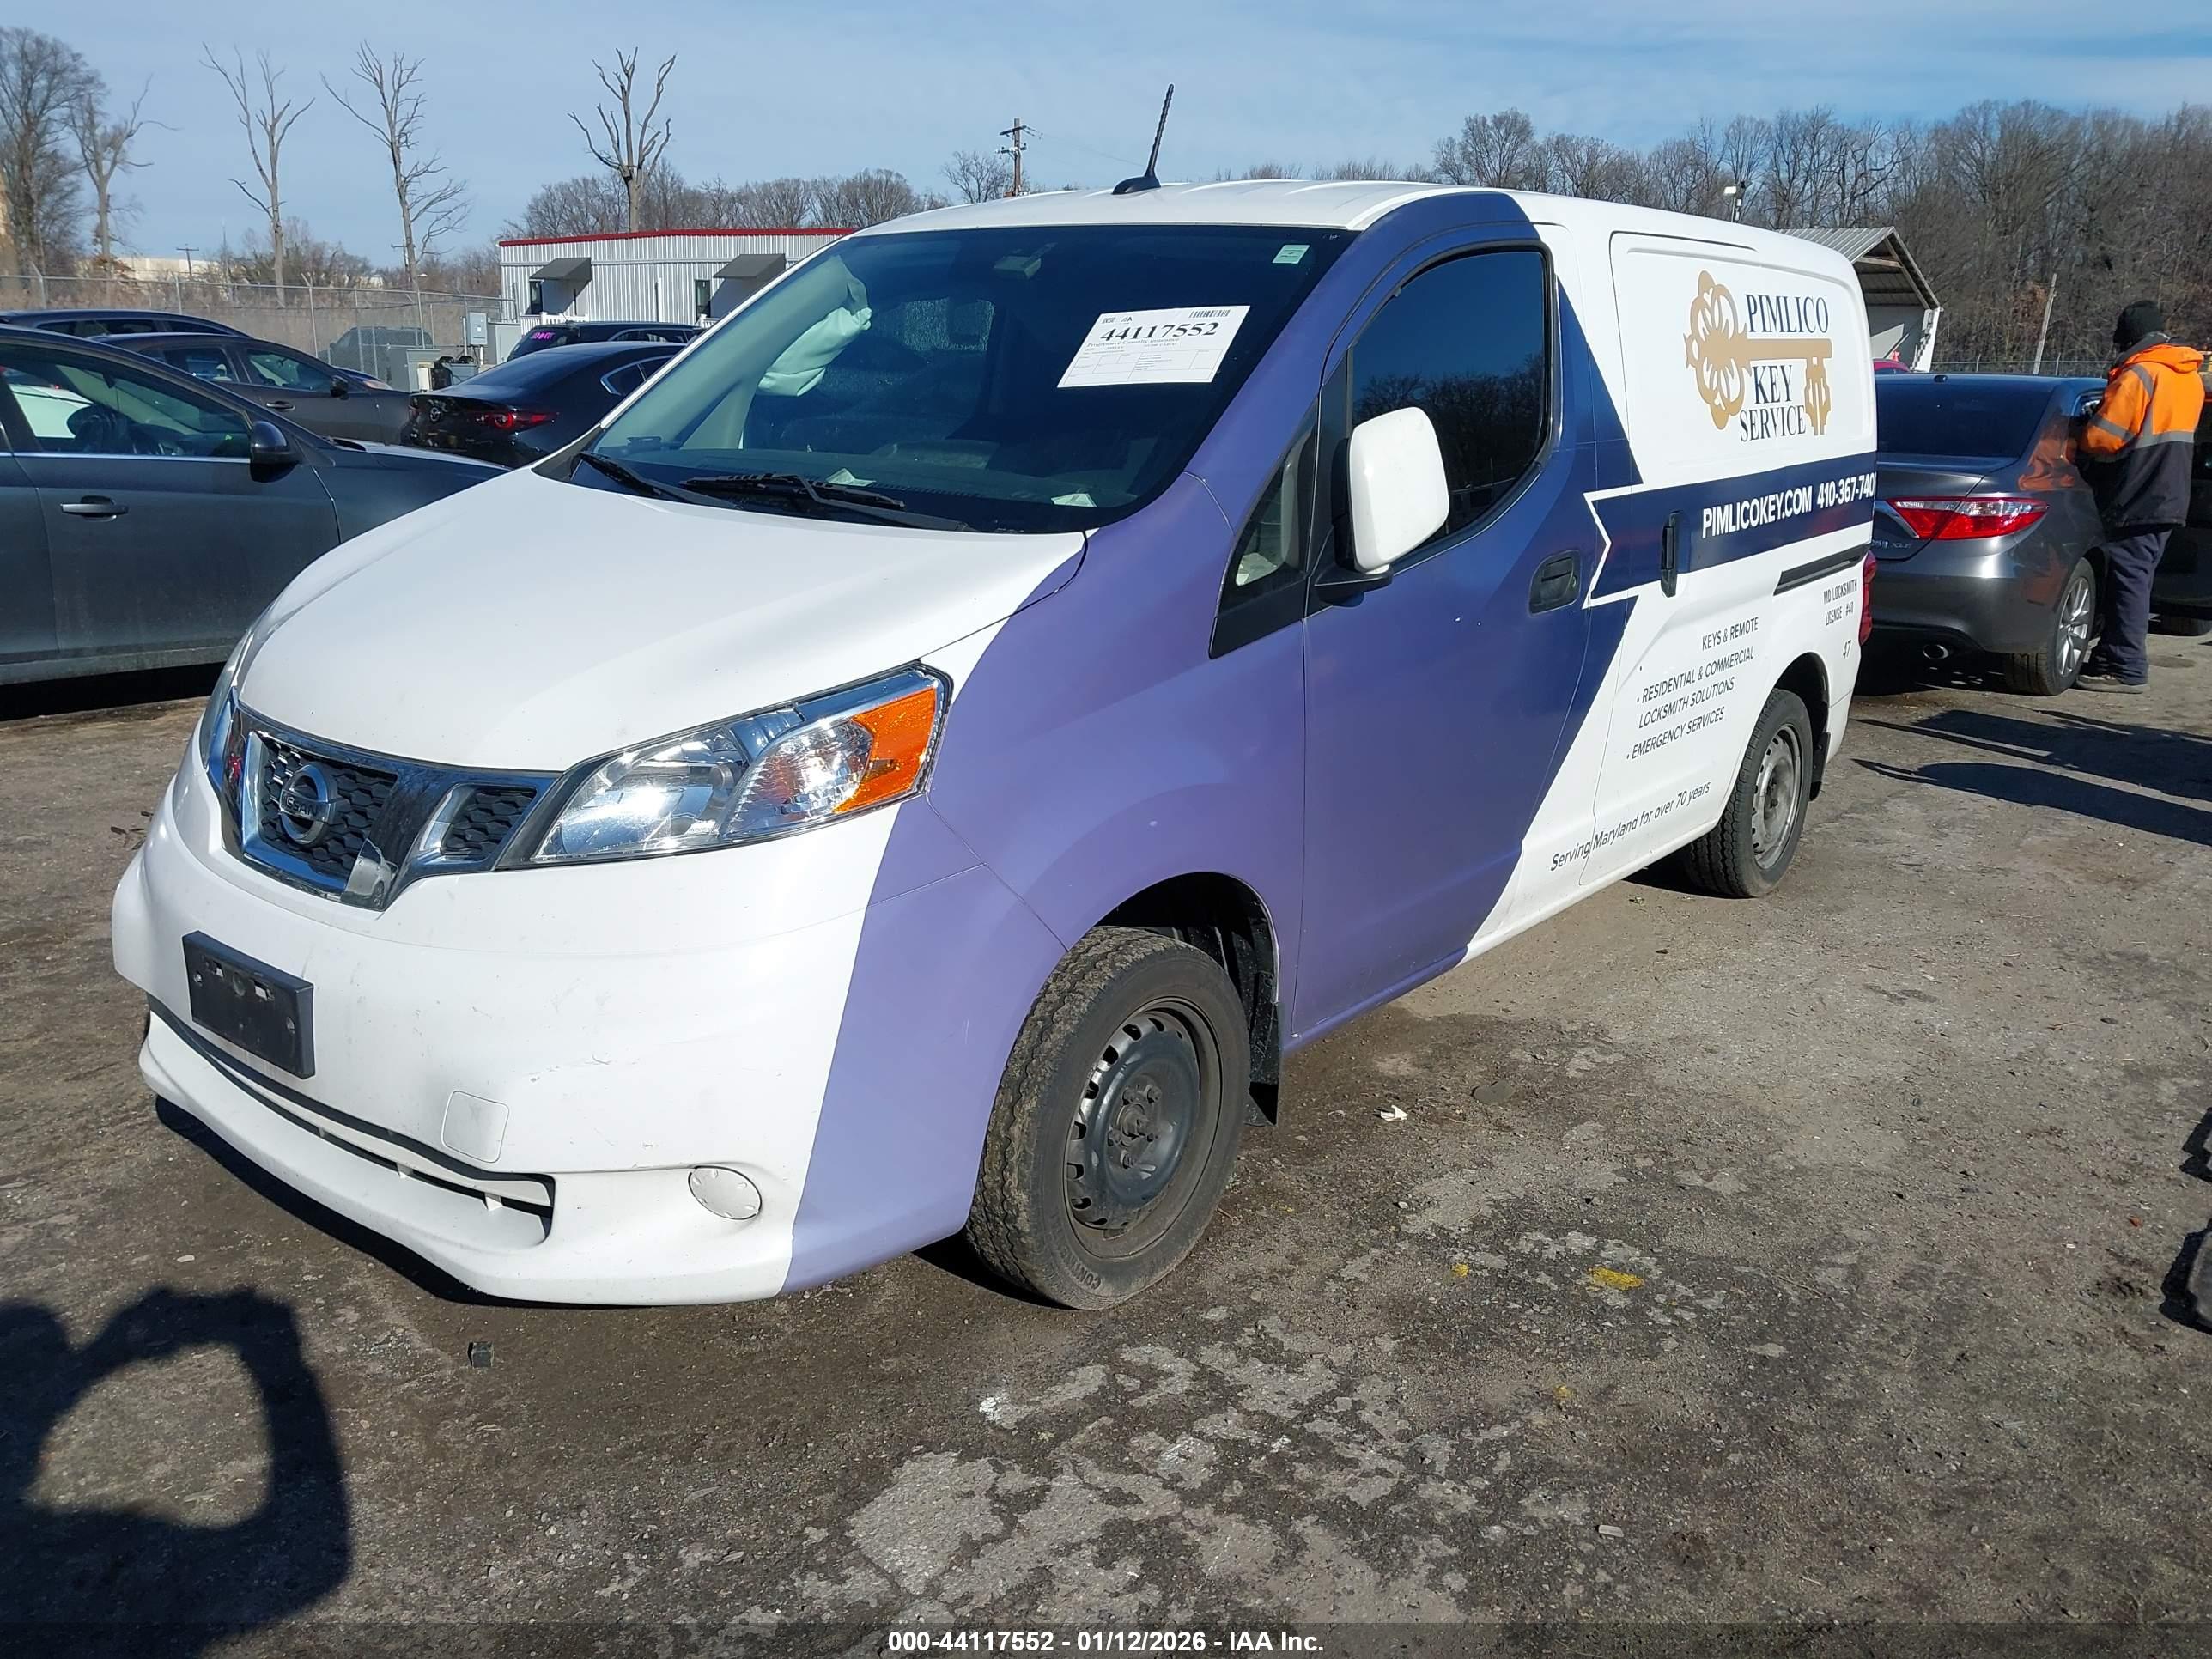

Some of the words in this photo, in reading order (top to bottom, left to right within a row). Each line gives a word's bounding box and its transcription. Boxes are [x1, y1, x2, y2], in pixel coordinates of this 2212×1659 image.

[1101, 322, 1219, 342] 44117552
[1745, 294, 1829, 333] PIMLICO
[1752, 364, 1792, 405] KEY
[1740, 404, 1807, 442] SERVICE
[1702, 485, 1813, 539] PIMLICOKEY.COM
[1832, 578, 1857, 601] LOCKSMITH
[1702, 630, 1722, 651] KEYS
[1723, 627, 1729, 643] &
[1729, 617, 1759, 641] REMOTE
[1825, 605, 1843, 626] LICENSE
[1842, 639, 1852, 659] 47
[1642, 668, 1696, 703] RESIDENTIAL
[1697, 665, 1704, 681] &
[1705, 646, 1754, 678] COMMERCIAL
[1638, 696, 1690, 729] LOCKSMITH
[1689, 677, 1735, 707] SOLUTIONS
[1632, 723, 1687, 760] EMERGENCY
[1686, 706, 1725, 735] SERVICES
[1550, 840, 1591, 872] Serving
[1592, 813, 1639, 850] Maryland
[1639, 808, 1654, 827] for
[1654, 799, 1675, 819] over
[1675, 790, 1687, 809] 70
[1686, 781, 1711, 807] years
